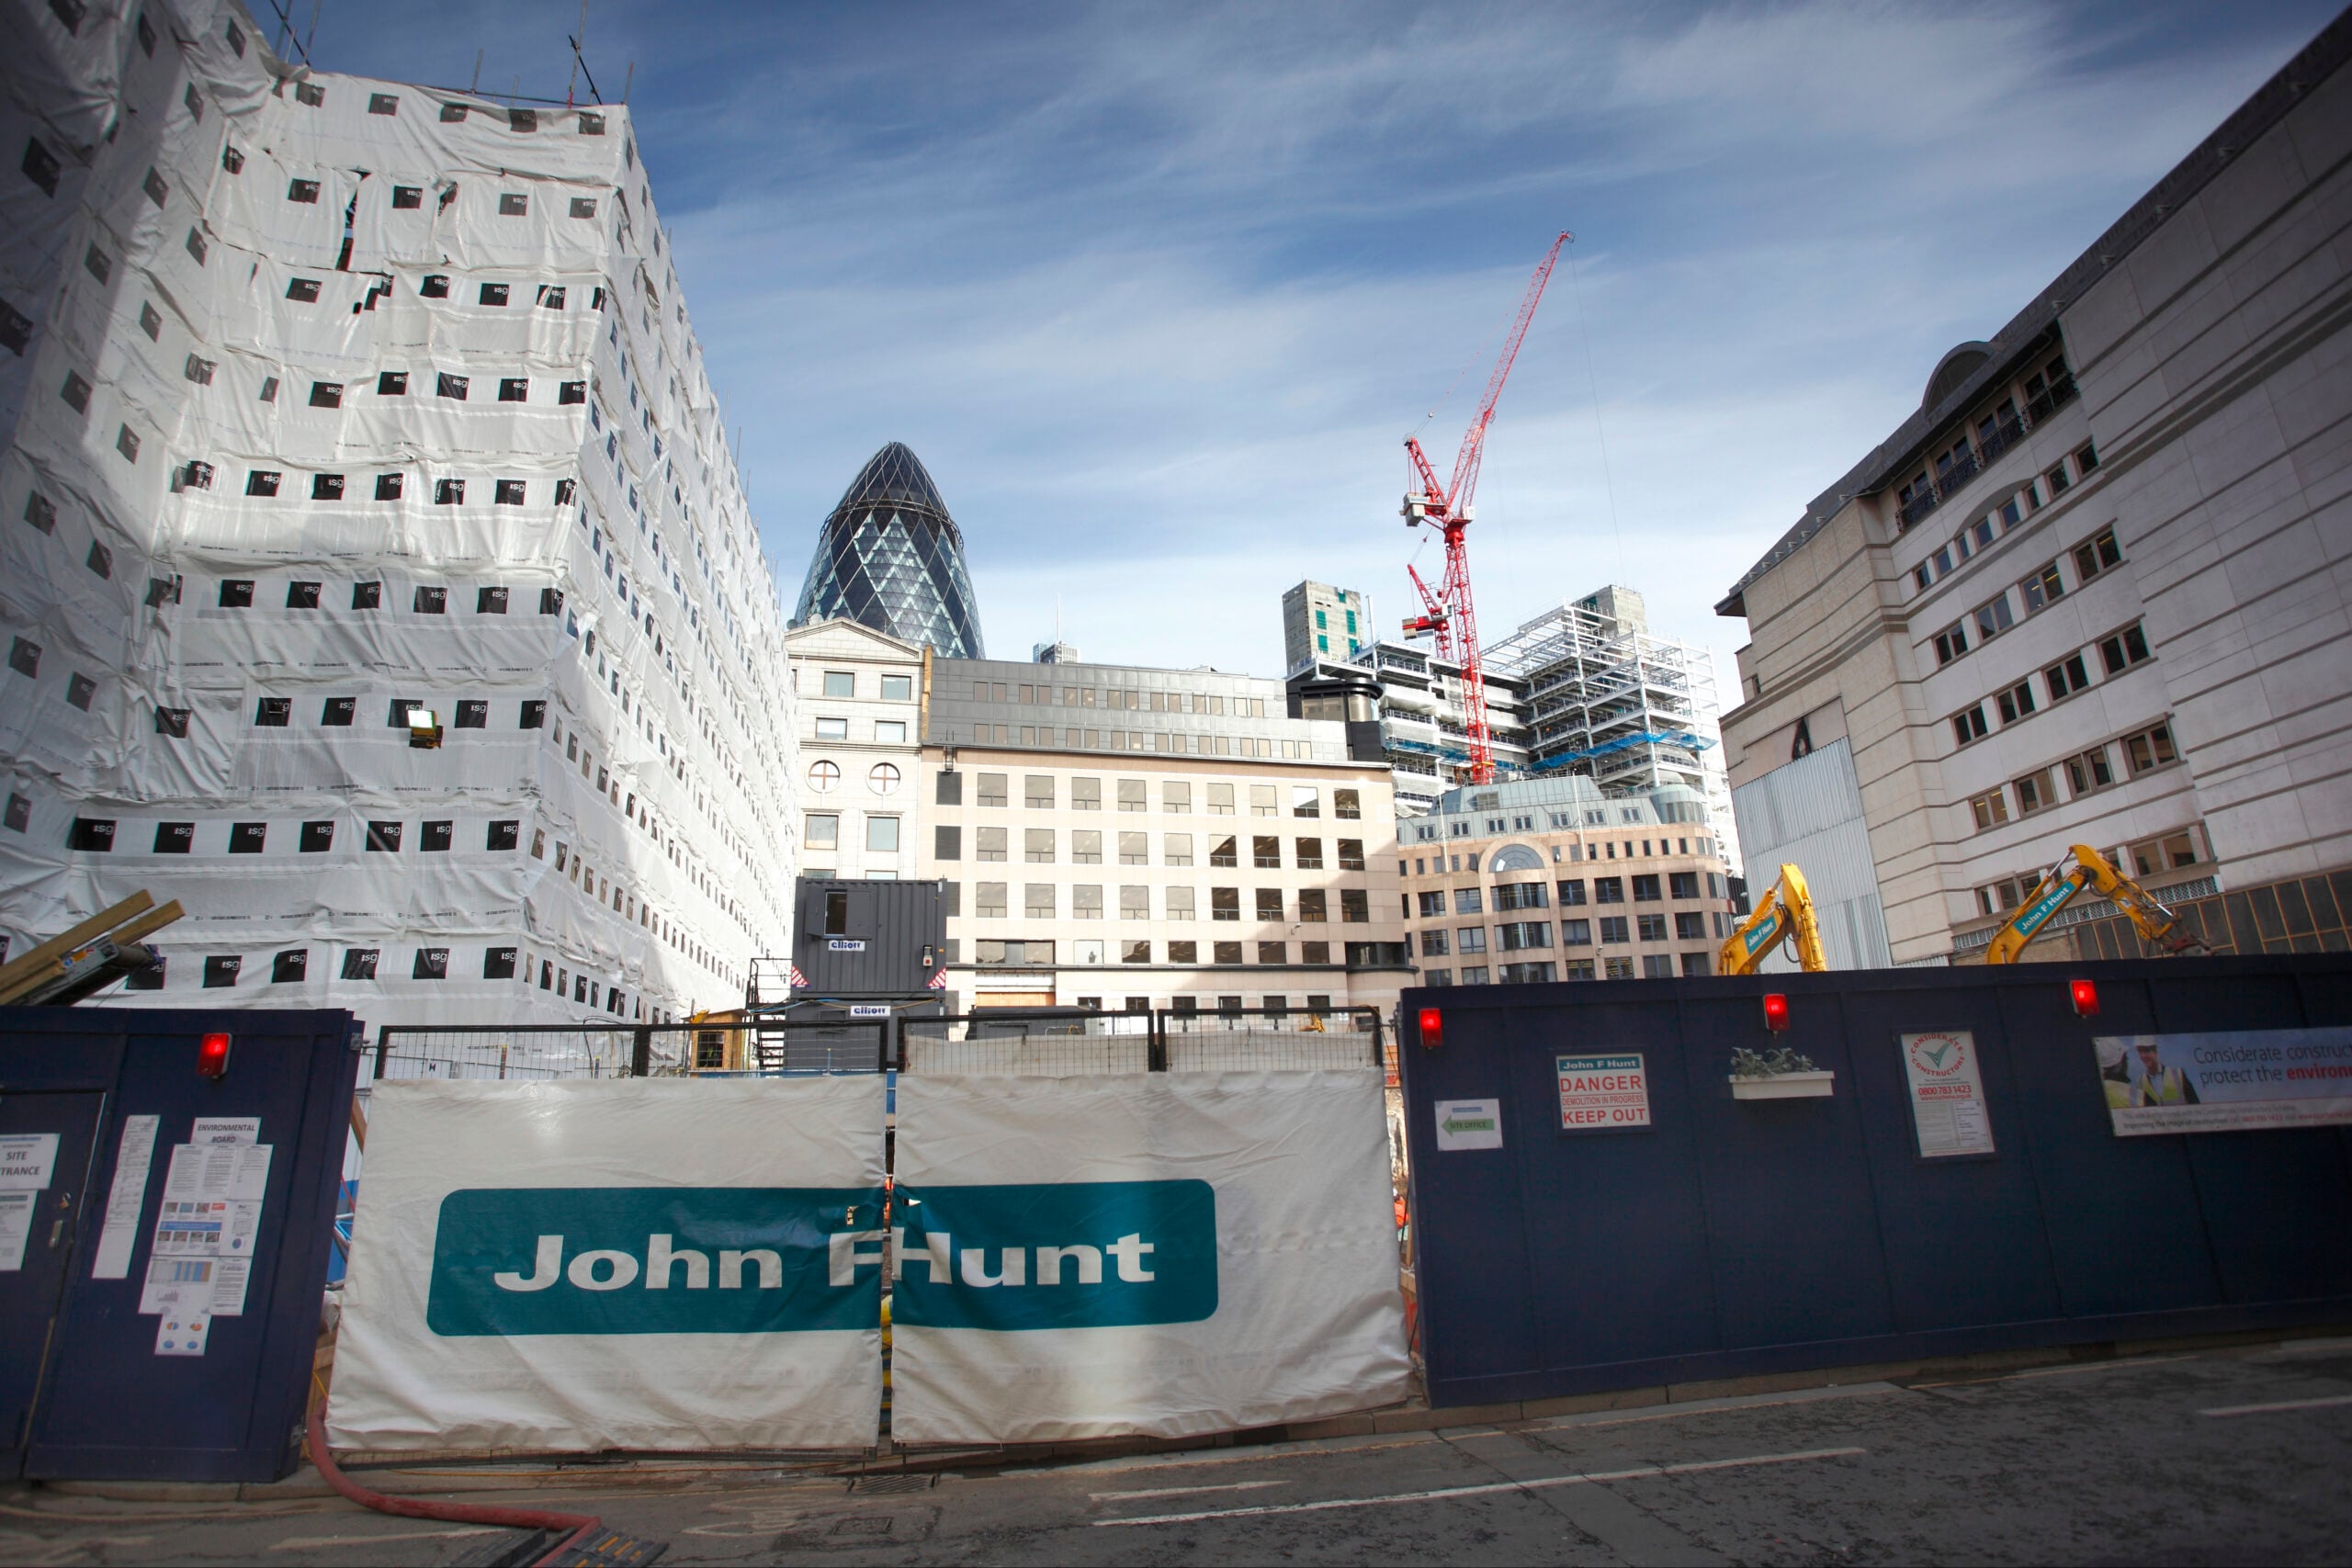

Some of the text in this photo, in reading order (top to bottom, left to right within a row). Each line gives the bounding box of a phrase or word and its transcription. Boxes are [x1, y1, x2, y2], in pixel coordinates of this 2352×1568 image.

[431, 591, 446, 600] isg
[338, 702, 355, 711] isg
[470, 705, 486, 714] isg
[93, 825, 114, 835] isg
[174, 827, 192, 837] isg
[248, 826, 266, 837] isg
[316, 826, 333, 836] isg
[384, 826, 401, 836] isg
[436, 825, 452, 835] isg
[503, 825, 517, 835] isg
[2022, 886, 2069, 931] John F Hunt
[289, 954, 306, 964] isg
[361, 953, 378, 963] isg
[431, 953, 447, 963] isg
[501, 953, 516, 962] isg
[221, 961, 240, 970] isg
[1911, 1032, 1964, 1055] CONSIDERATE
[2192, 1044, 2283, 1065] Considerate
[1911, 1055, 1964, 1077] CONSTRUCTORS
[2199, 1066, 2253, 1088] protect
[2256, 1065, 2283, 1082] the
[1560, 1075, 1643, 1092] DANGER
[1918, 1085, 1972, 1096] 0800 783 1423
[1562, 1097, 1600, 1106] DEMOLITION
[1610, 1094, 1644, 1103] PROGRESS
[1563, 1108, 1645, 1124] KEEP OUT
[198, 1123, 255, 1132] ENVIRONMENTAL
[211, 1135, 236, 1144] BOARD
[6, 1150, 28, 1161] SITE
[493, 1226, 1155, 1292] John F Hunt
